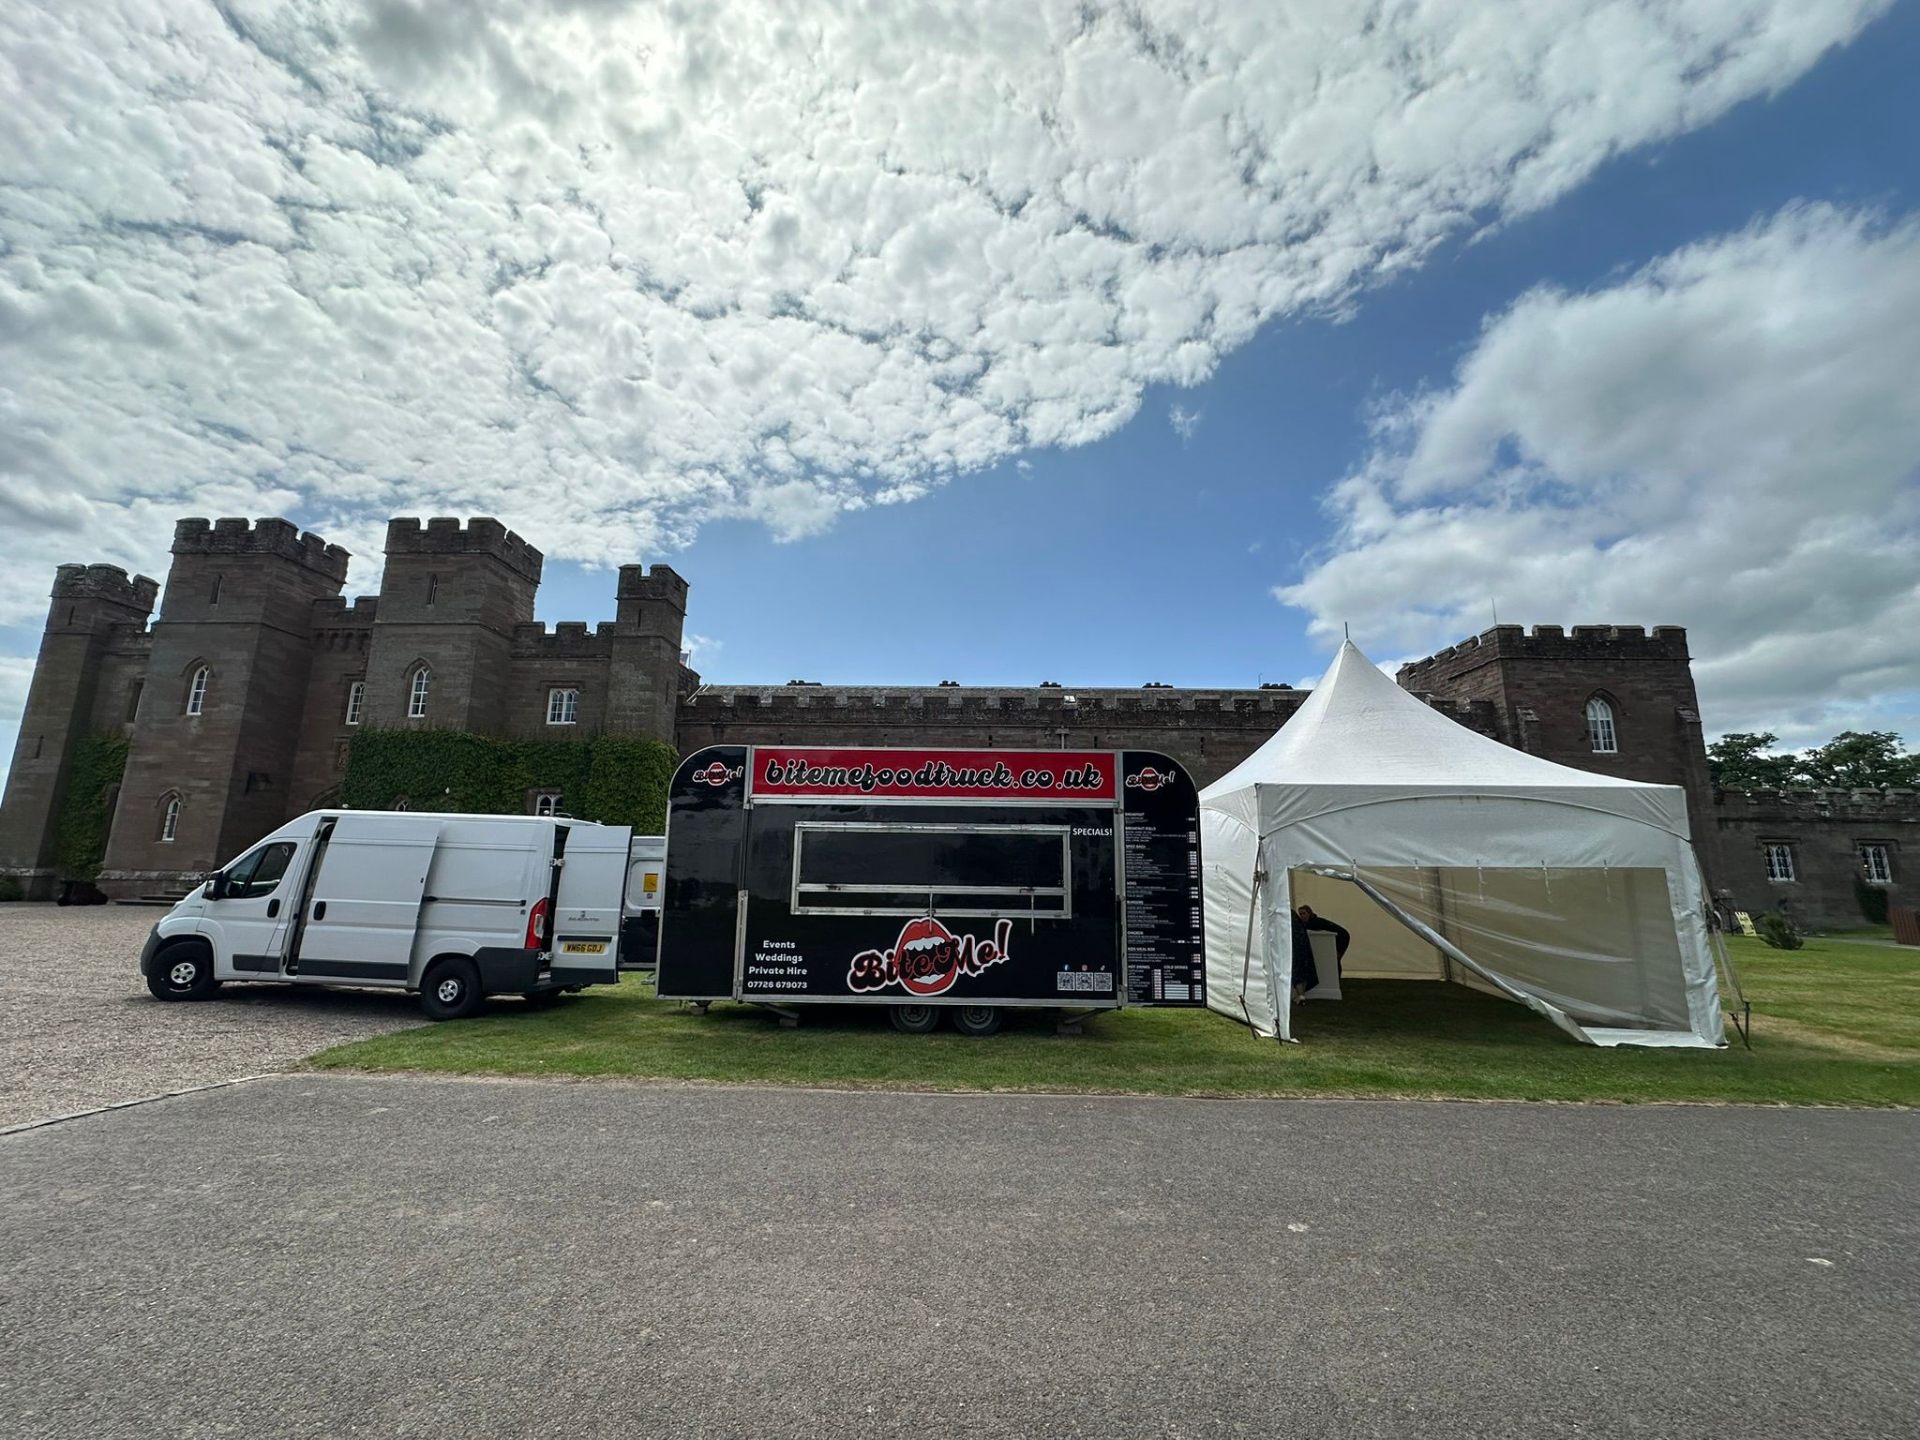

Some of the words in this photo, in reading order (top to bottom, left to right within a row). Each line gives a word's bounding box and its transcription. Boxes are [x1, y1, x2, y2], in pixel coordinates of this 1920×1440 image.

[765, 759, 1104, 792] bitemefoodtruck.co.uk
[1072, 827, 1112, 836] SPECIALS!
[566, 943, 586, 953] WM66
[763, 940, 795, 949] Events
[755, 952, 803, 965] Weddings
[847, 949, 933, 993] Bite
[933, 919, 1013, 978] Me!
[749, 965, 784, 974] Private
[787, 966, 808, 975] Hire
[747, 981, 774, 989] 07726
